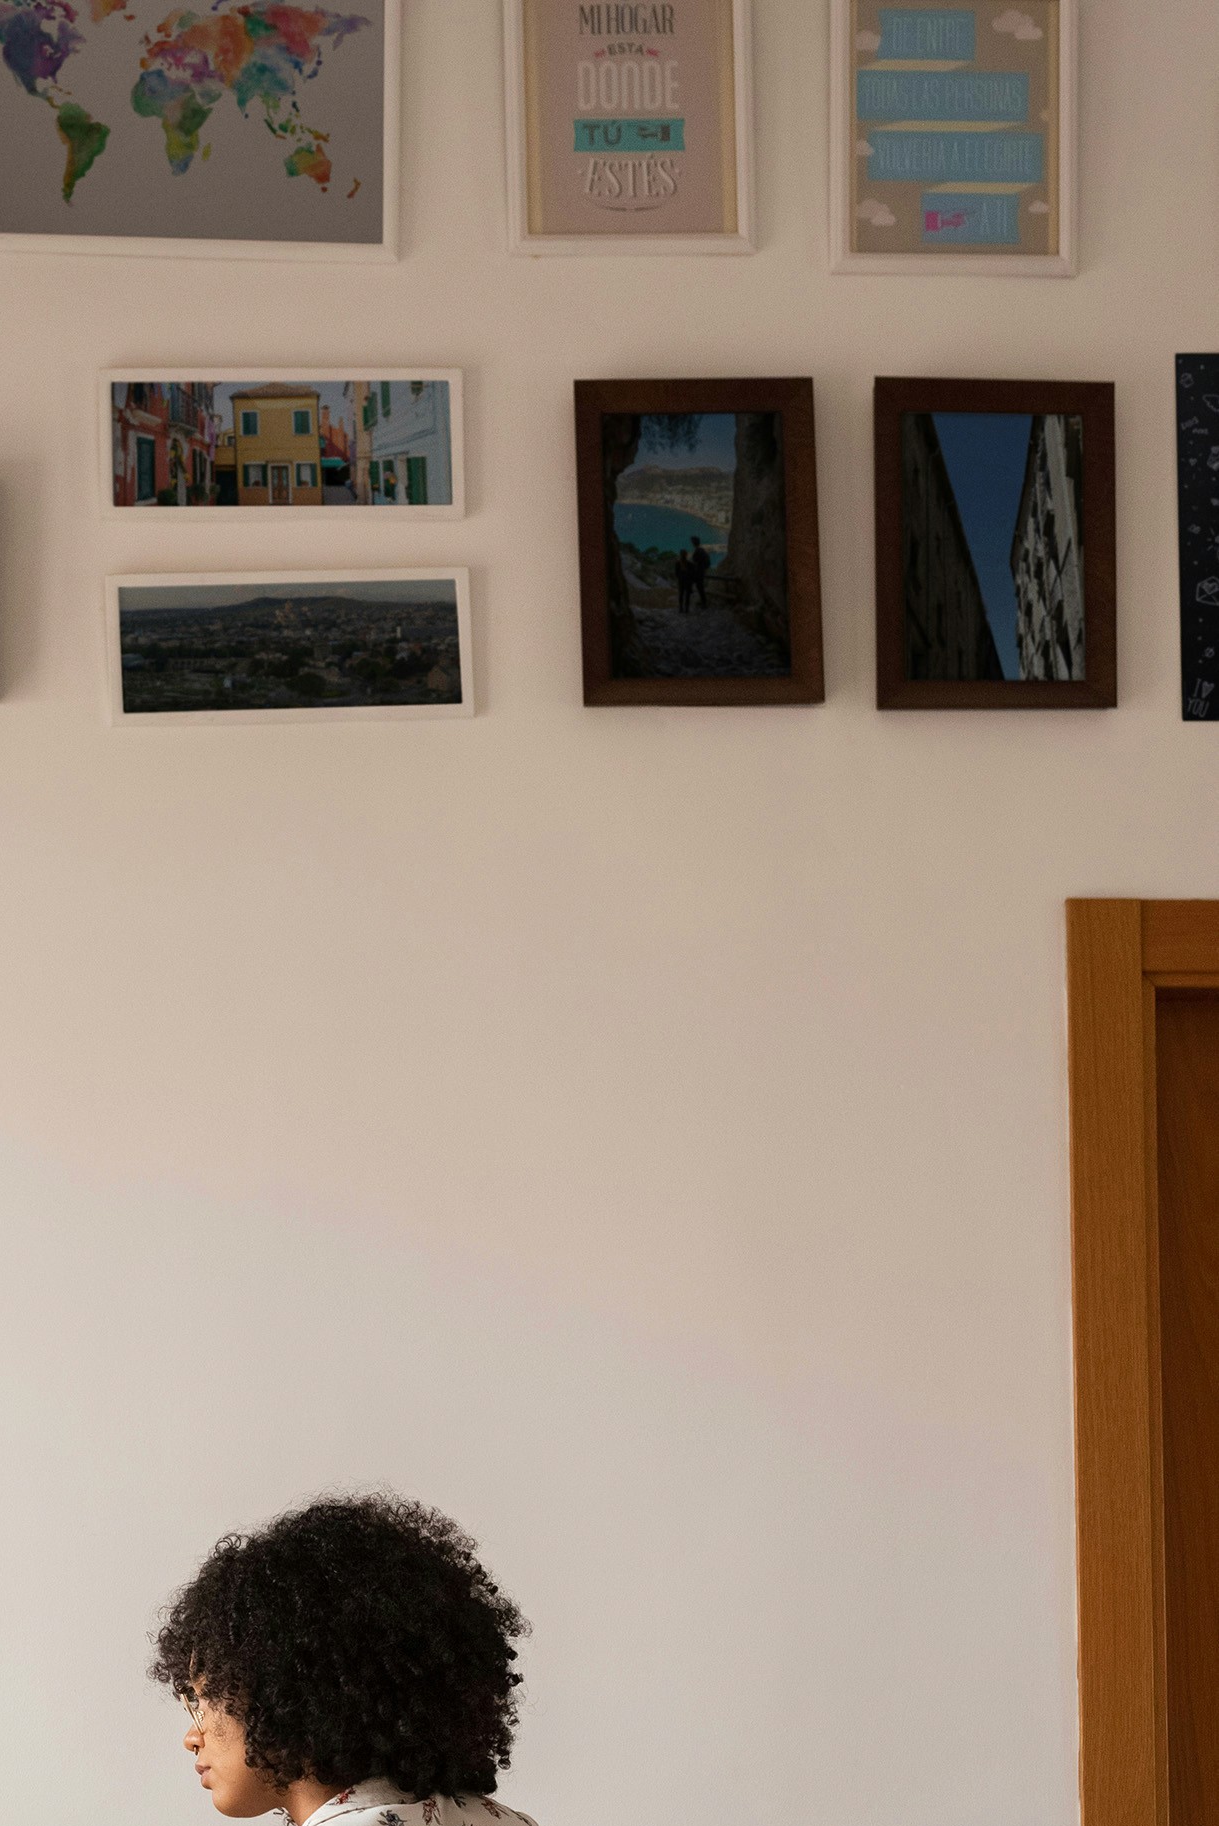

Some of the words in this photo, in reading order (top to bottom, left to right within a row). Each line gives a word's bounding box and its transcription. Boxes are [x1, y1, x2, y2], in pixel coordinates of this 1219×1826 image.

[579, 3, 602, 35] MI
[606, 3, 675, 35] HOGAR
[577, 60, 680, 110] DONDE
[582, 120, 622, 146] TÚ
[585, 153, 677, 198] ESTÉS
[1187, 697, 1210, 718] YOU
